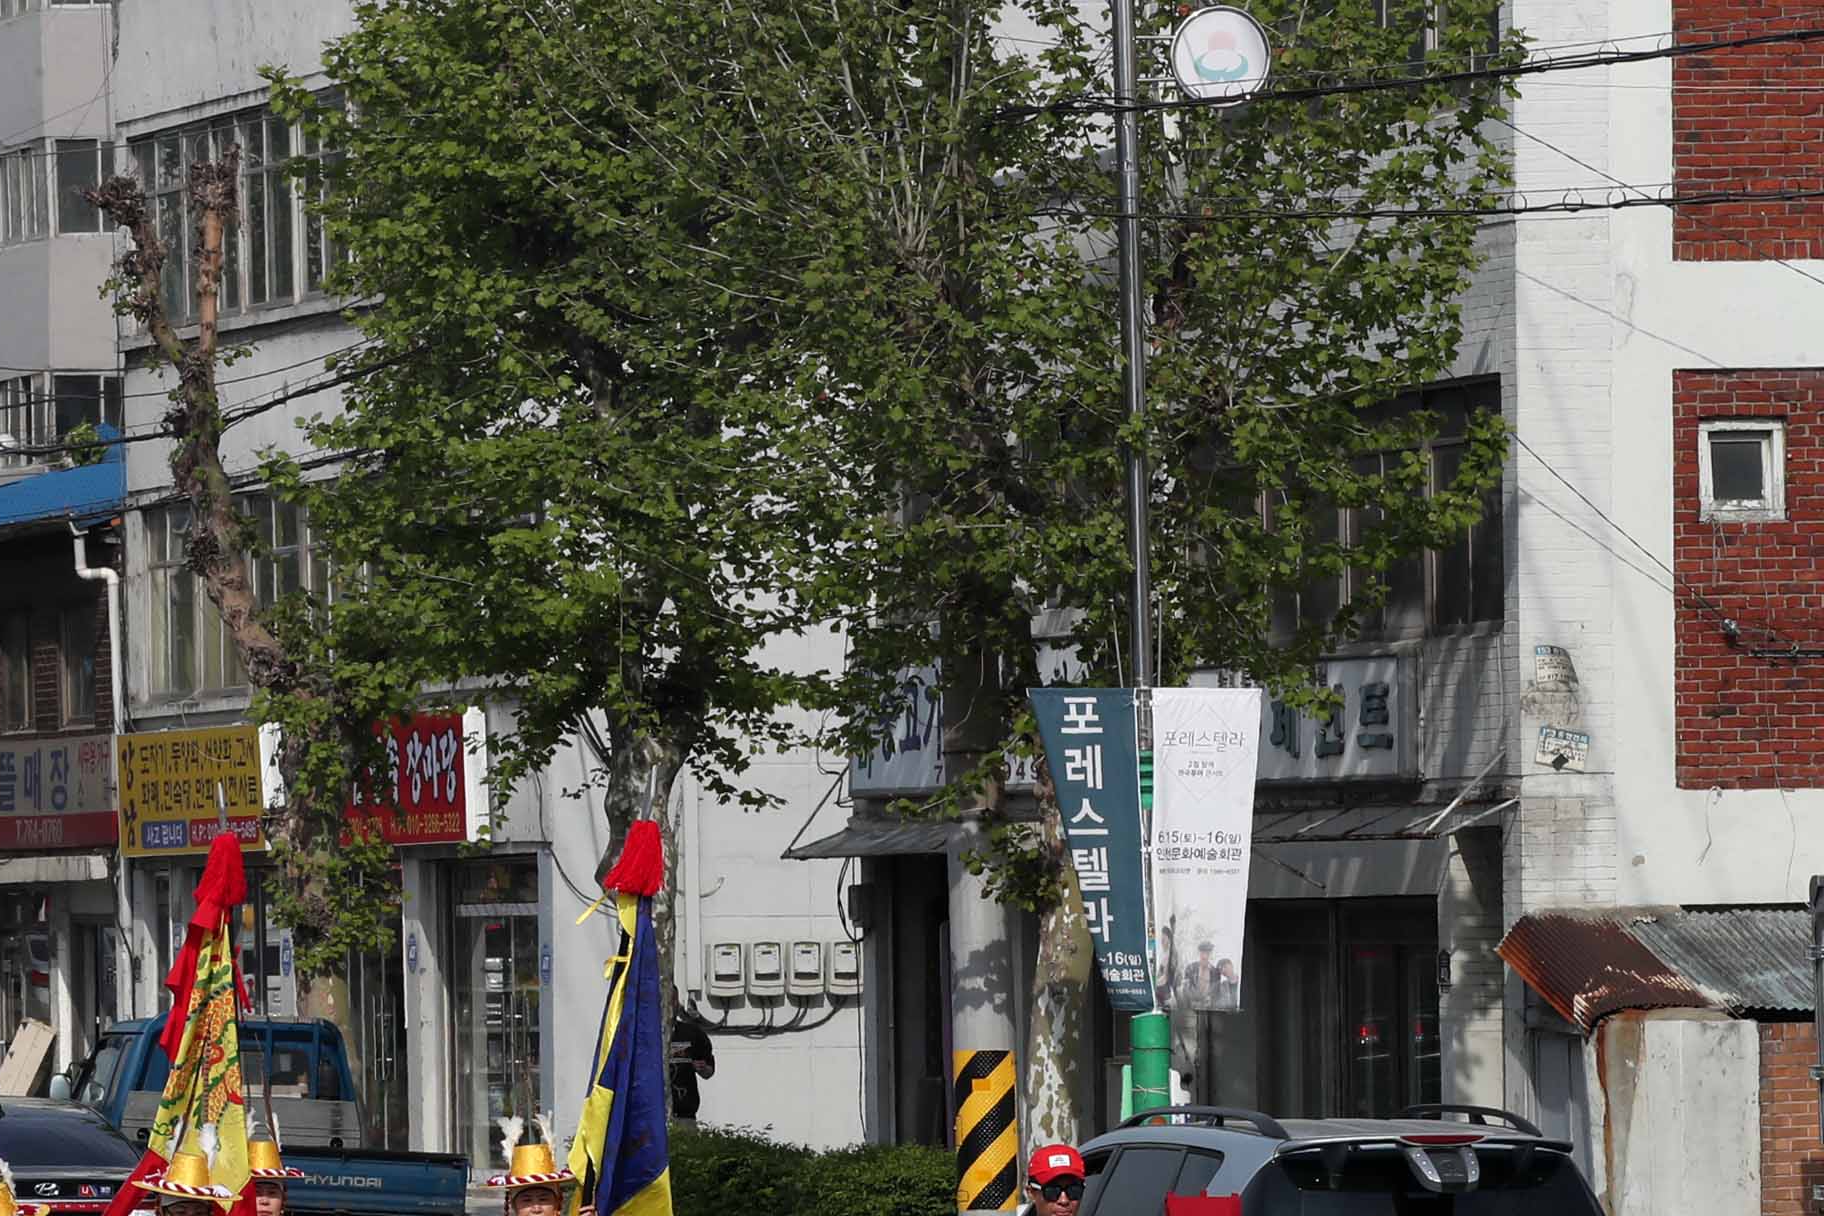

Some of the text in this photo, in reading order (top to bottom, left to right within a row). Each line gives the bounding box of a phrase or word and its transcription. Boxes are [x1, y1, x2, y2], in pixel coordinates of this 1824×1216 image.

[1162, 731, 1245, 752] 포레스텔라
[1061, 696, 1115, 943] 포레스텔라
[304, 1174, 383, 1189] HYUNDAI
